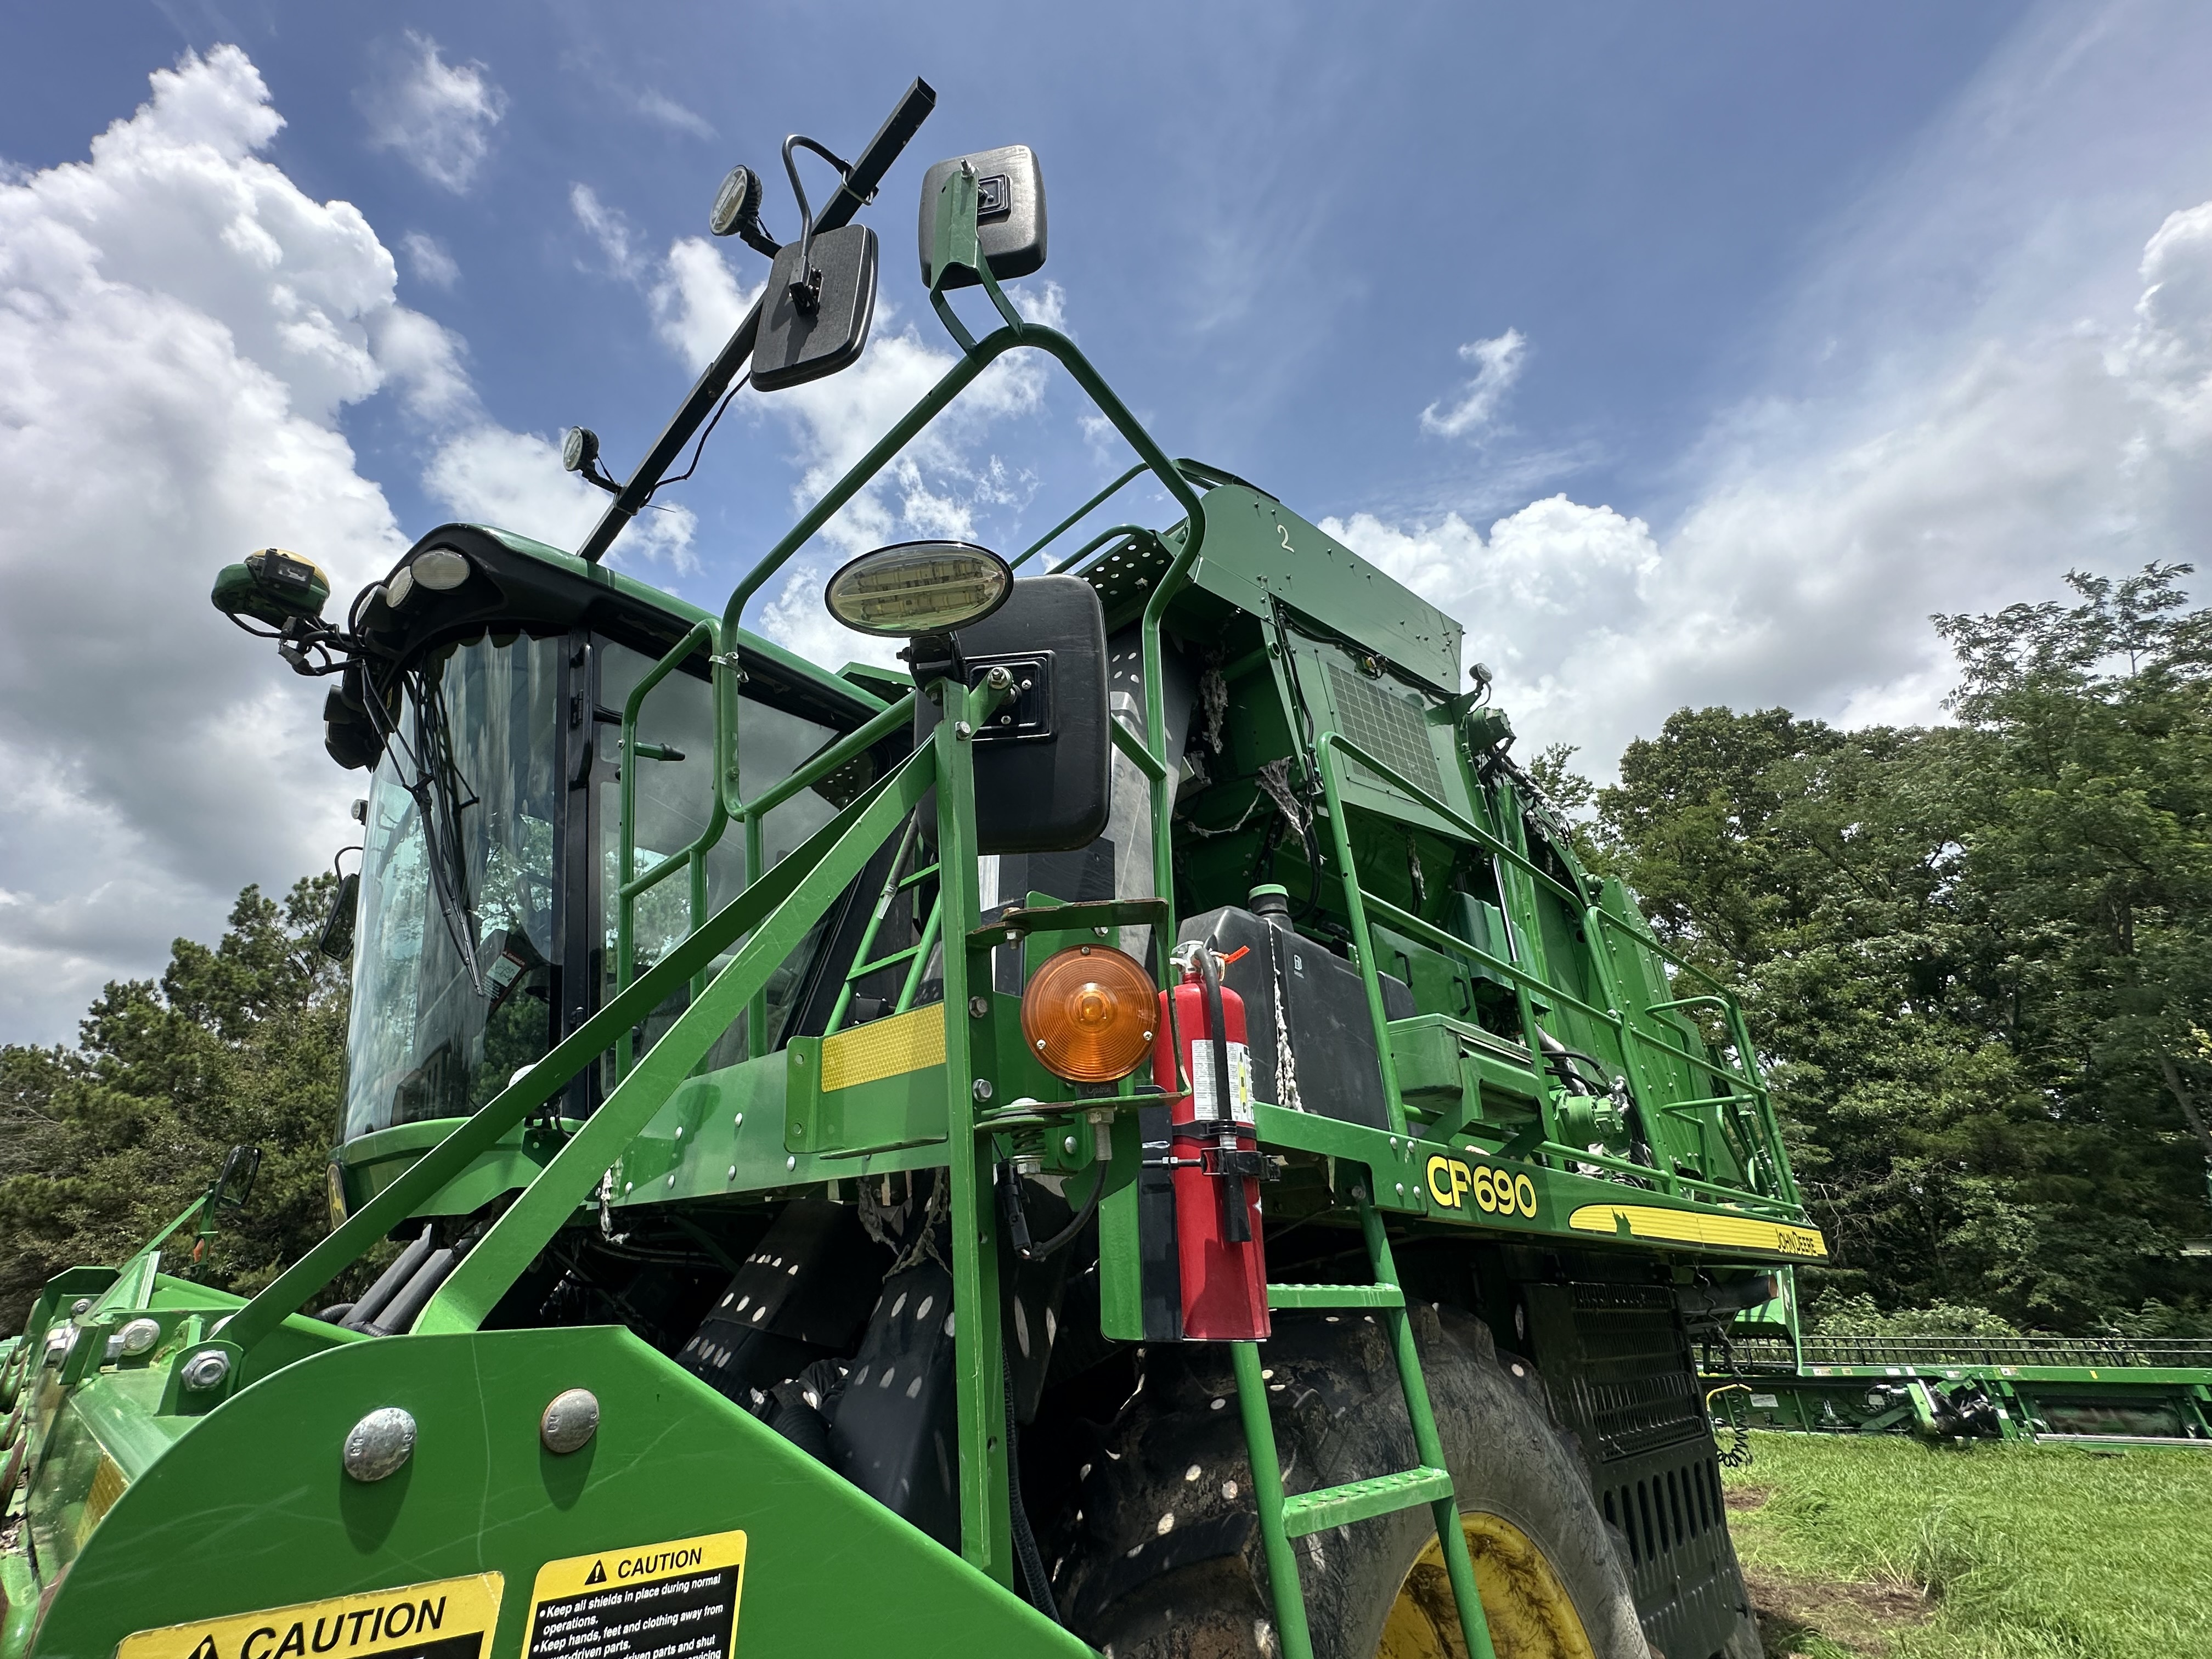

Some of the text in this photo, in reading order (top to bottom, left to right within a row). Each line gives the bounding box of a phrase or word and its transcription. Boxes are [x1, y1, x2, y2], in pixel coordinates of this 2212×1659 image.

[1276, 524, 1295, 553] 2
[1239, 1052, 1243, 1063] A
[1240, 1076, 1245, 1087] B
[1243, 1102, 1246, 1113] C
[618, 1548, 702, 1578] CAUTION
[546, 1573, 721, 1618] Keep all shields in place during normal
[240, 1596, 447, 1659] CAUTION
[539, 1604, 724, 1654] Keep hands, feet and clothing away from
[543, 1614, 599, 1636] operations.
[603, 1640, 631, 1657] parts.
[653, 1644, 676, 1659] parts
[678, 1638, 695, 1653] and
[696, 1634, 715, 1649] shut
